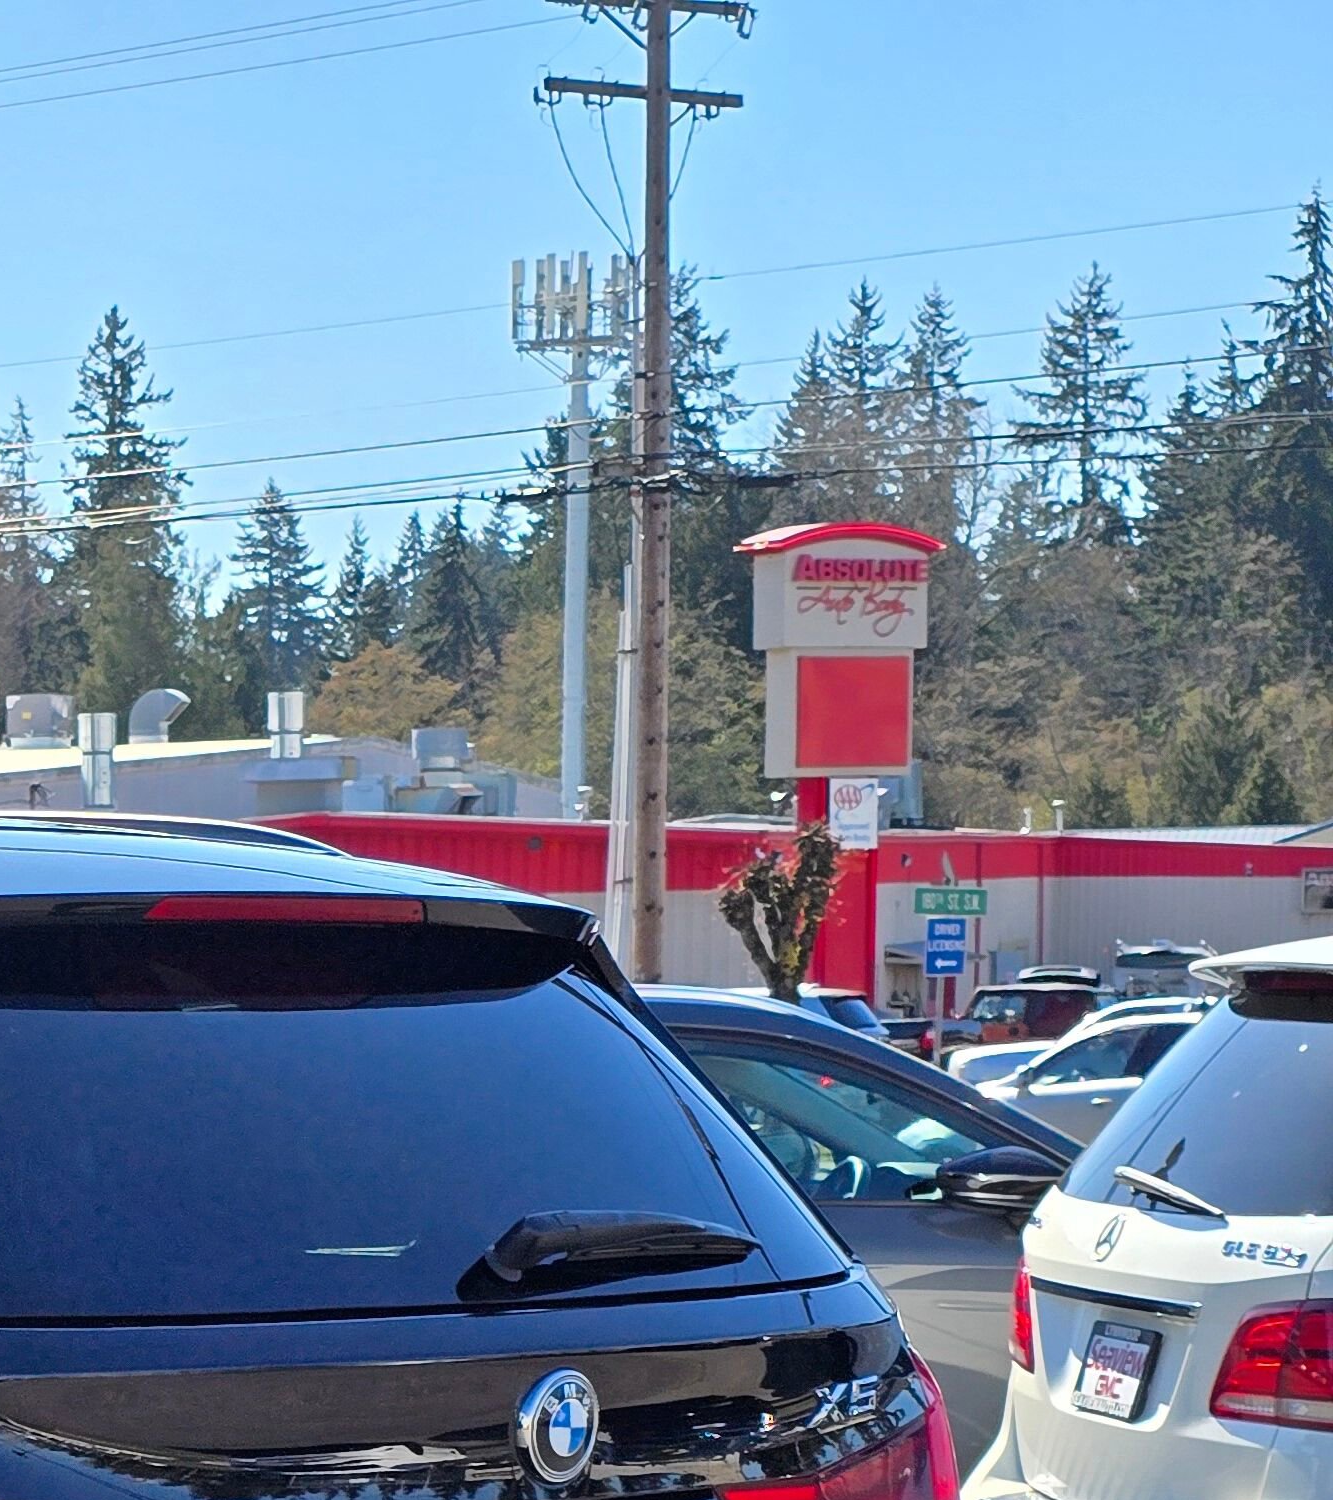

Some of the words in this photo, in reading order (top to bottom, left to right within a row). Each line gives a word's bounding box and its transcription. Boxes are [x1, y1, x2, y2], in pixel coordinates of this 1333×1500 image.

[793, 555, 929, 582] ABSOLUTE
[797, 584, 855, 625] Auto
[860, 578, 915, 637] Body
[934, 923, 961, 936] DRIVER
[807, 1375, 878, 1428] X5
